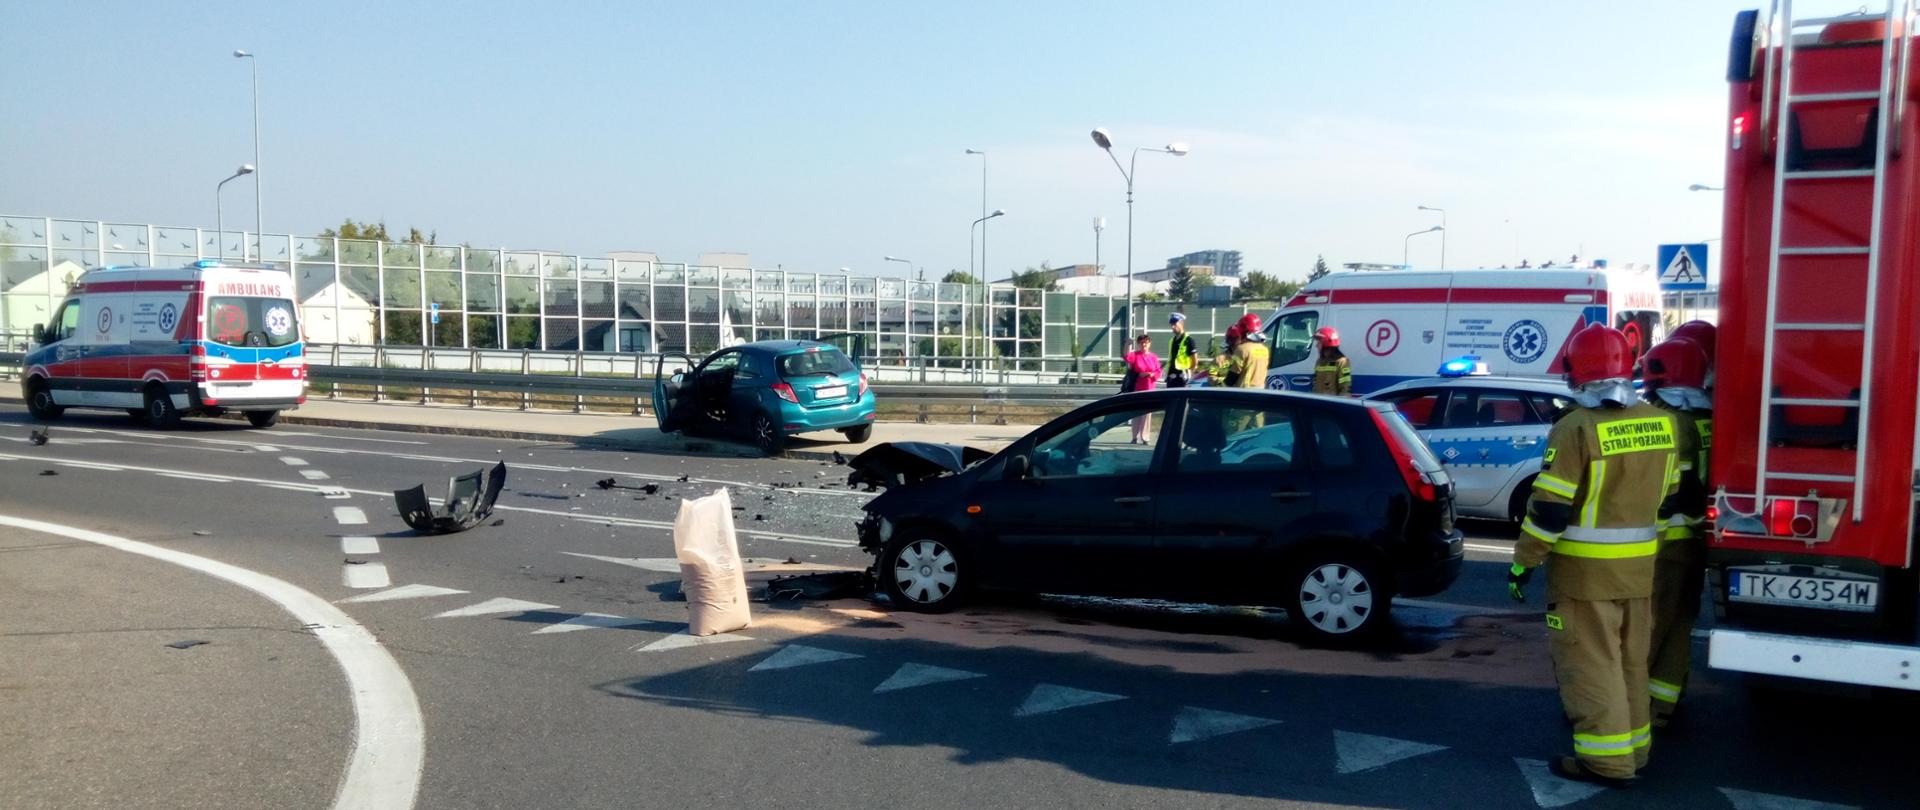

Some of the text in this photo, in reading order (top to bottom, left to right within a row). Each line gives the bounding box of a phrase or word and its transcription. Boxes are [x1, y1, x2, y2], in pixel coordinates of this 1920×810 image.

[218, 283, 281, 296] AMBULANS
[1376, 327, 1391, 348] P
[1746, 575, 1870, 605] TK 6354W
